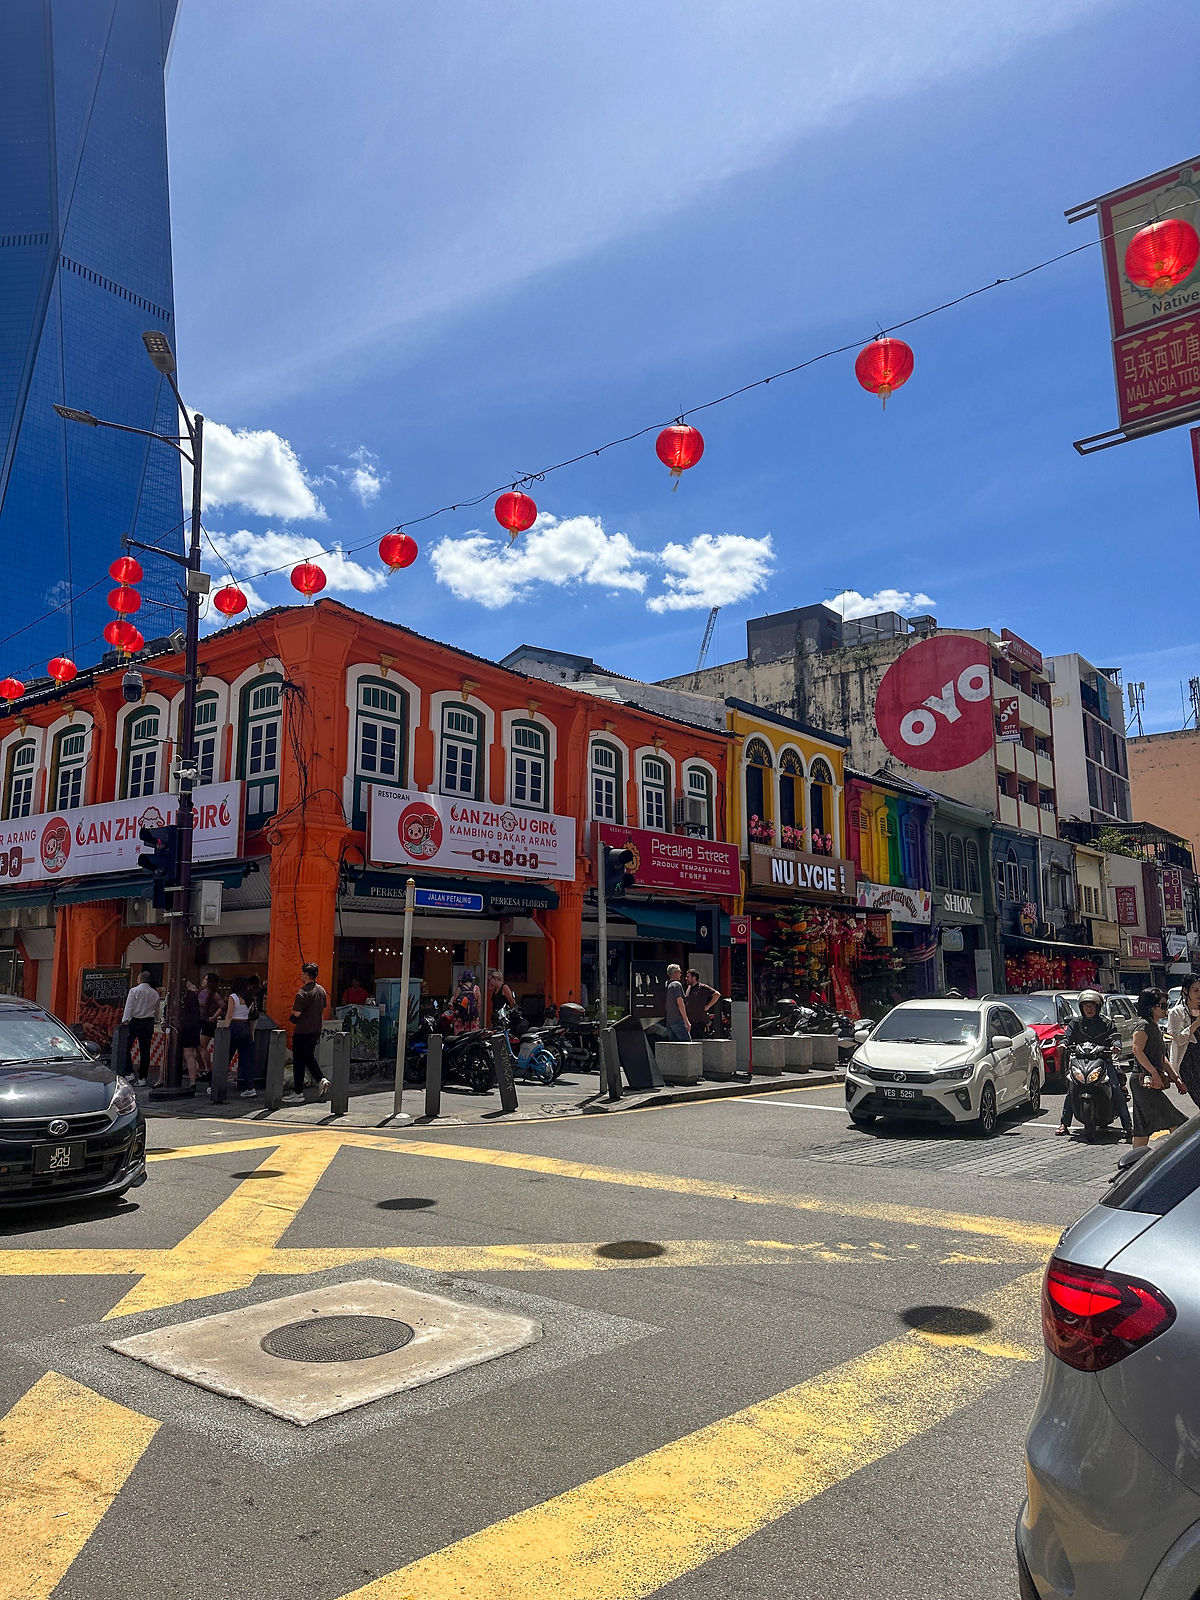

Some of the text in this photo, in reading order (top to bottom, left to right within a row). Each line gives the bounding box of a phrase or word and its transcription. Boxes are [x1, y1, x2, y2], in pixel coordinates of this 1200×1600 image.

[1152, 291, 1200, 314] Native
[1127, 373, 1177, 403] MALAYSIA
[900, 664, 991, 746] OYO
[1001, 700, 1017, 722] OYO
[378, 790, 410, 801] RESTORAN
[7, 829, 37, 845] ARANG
[449, 825, 557, 848] KAMBING BAKAR ARANG
[652, 838, 693, 859] Petaling
[697, 846, 730, 864] Street
[652, 860, 731, 876] PRODUK TEMPATAN KHAS
[771, 858, 795, 885] NU
[797, 863, 837, 891] LYCIE
[370, 887, 407, 898] PERKESA
[427, 893, 446, 902] JALAN
[446, 895, 472, 905] PETALING
[1171, 870, 1180, 910] HOTEL
[490, 896, 548, 909] PERKESA FLORIST
[944, 893, 974, 915] SHIOK
[883, 1089, 915, 1098] VES 5251
[51, 1147, 71, 1159] JPU
[50, 1157, 70, 1169] 249
